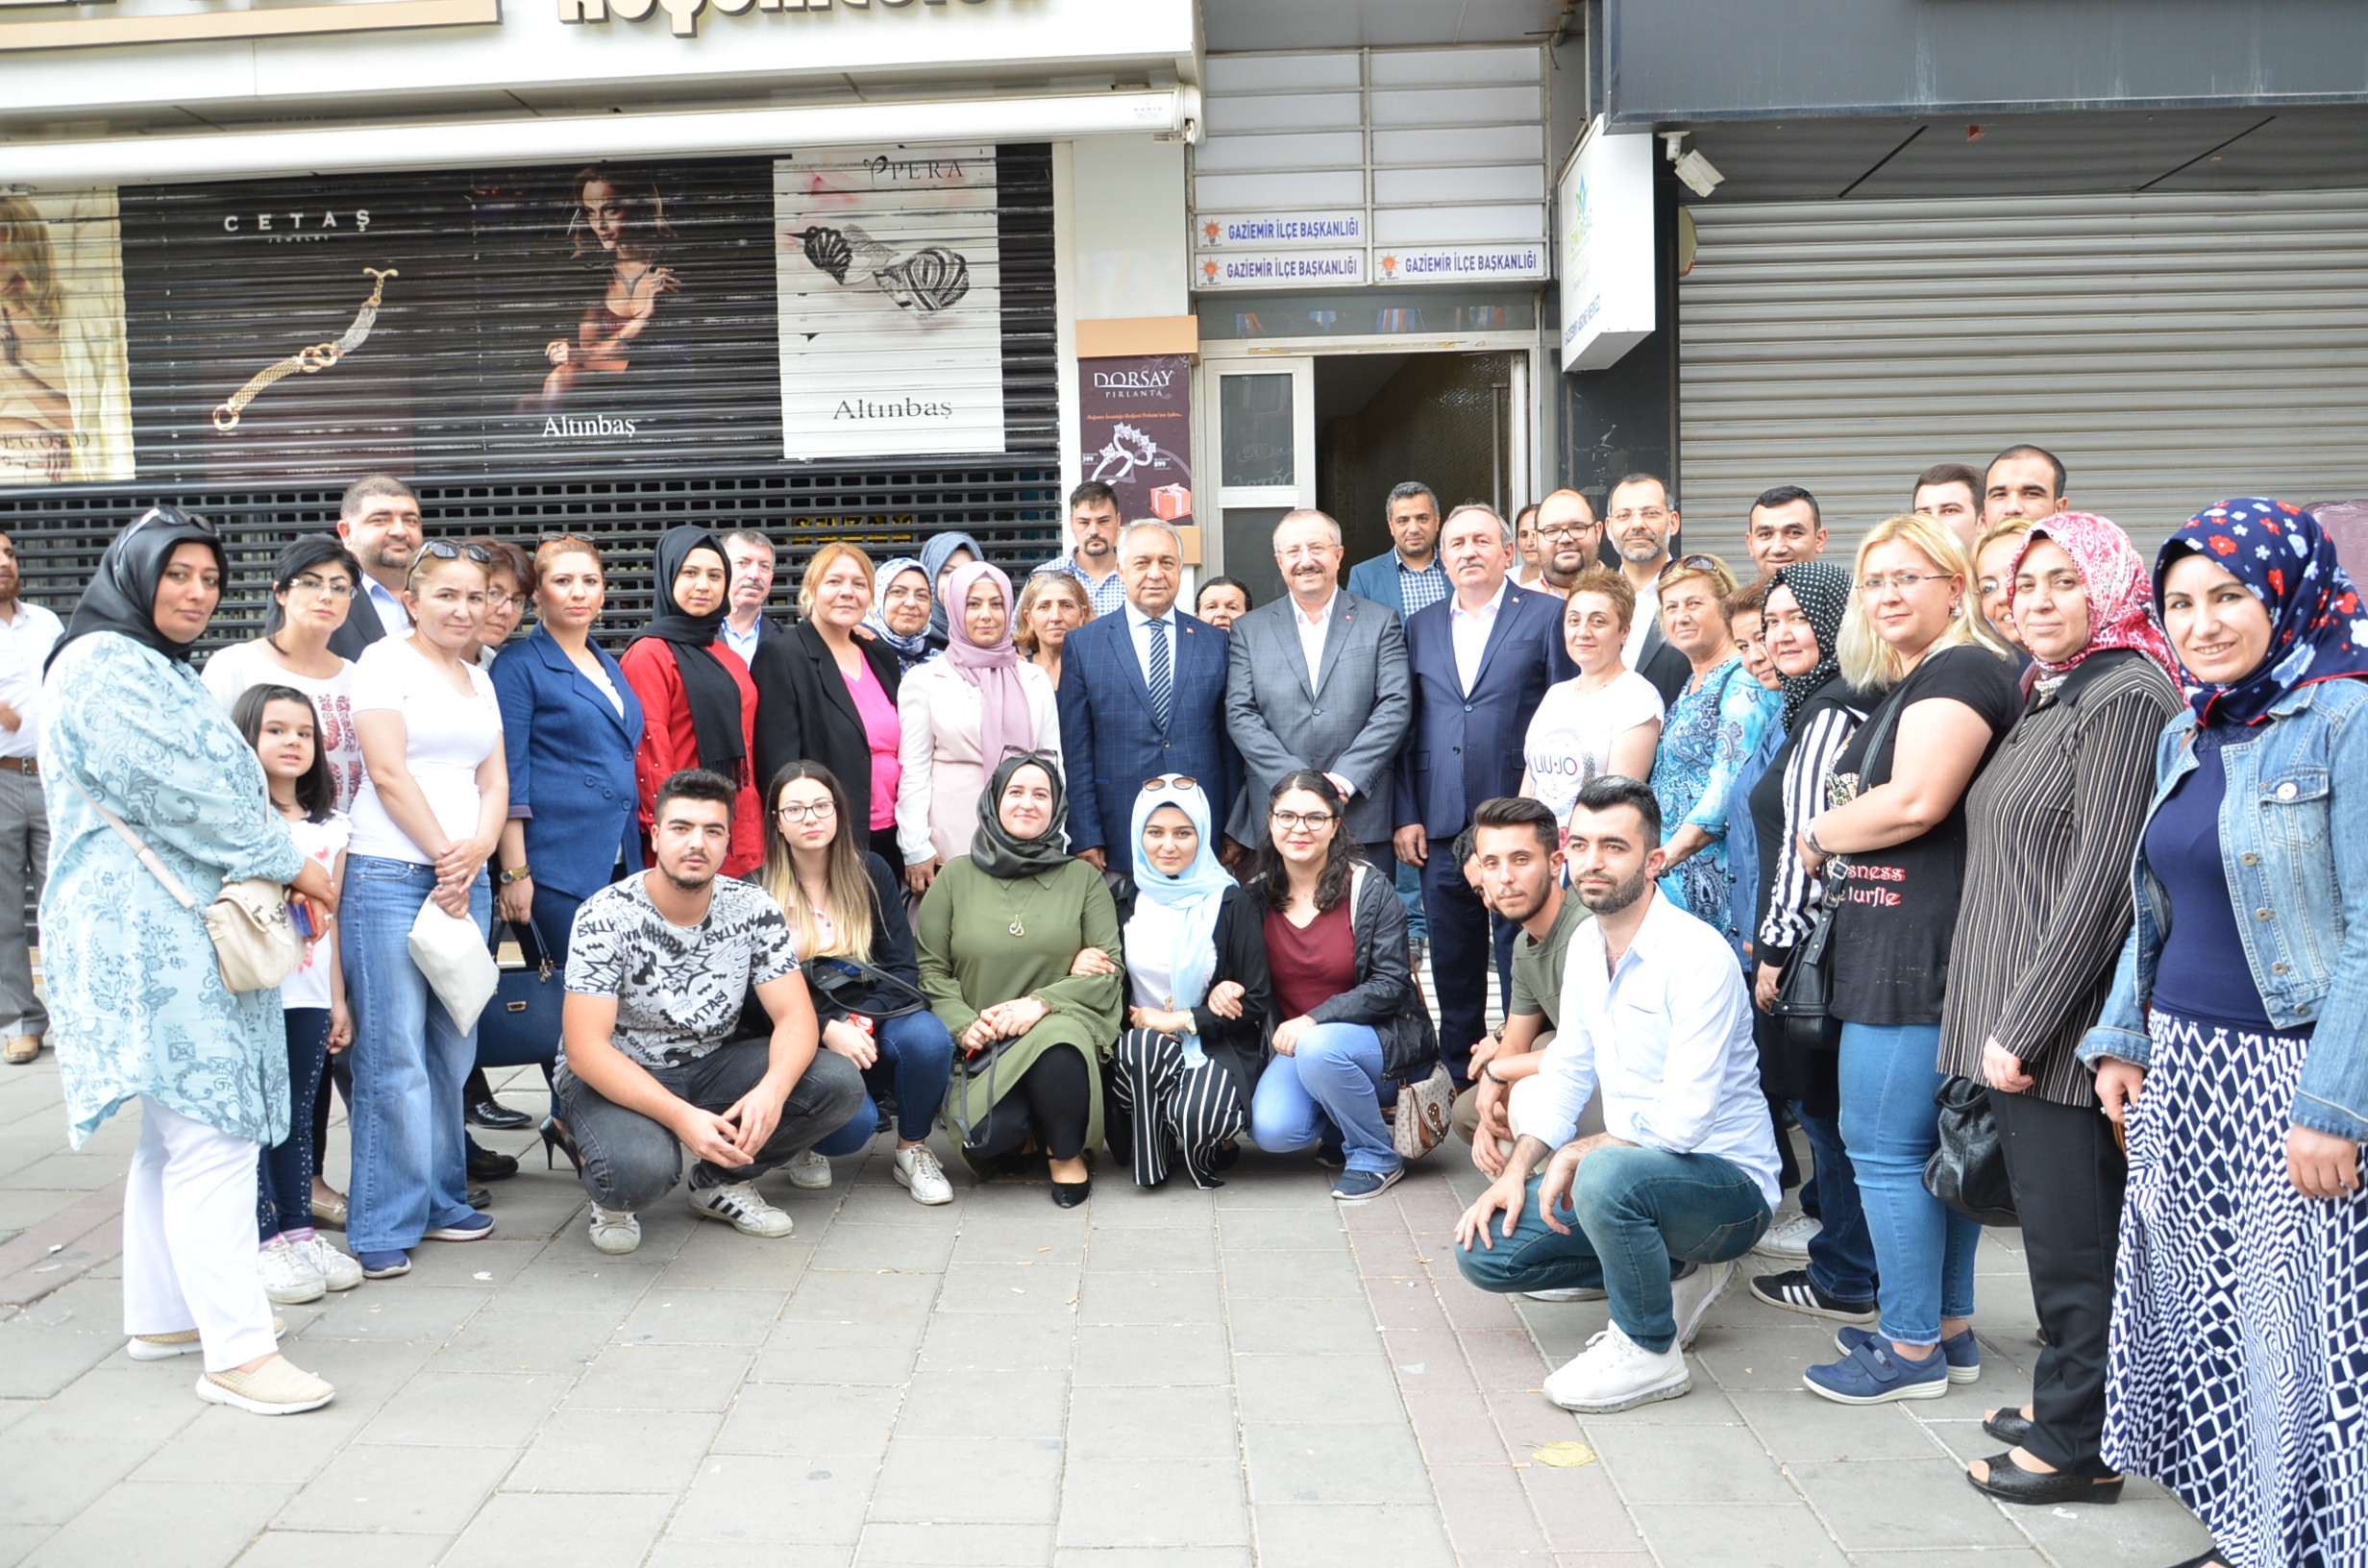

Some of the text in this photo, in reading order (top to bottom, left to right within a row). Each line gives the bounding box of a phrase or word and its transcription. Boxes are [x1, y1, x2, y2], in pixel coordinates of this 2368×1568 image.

[223, 209, 370, 233] CETAŞ
[1228, 217, 1359, 240] GAZİEMİR İLÇE BAŞKANLIĞI
[1226, 256, 1357, 279] GAZİEMİR İLÇE BAŞKANLIĞI
[1405, 250, 1537, 273] GAZİEMİR İLÇE BAŞKANLIĞI
[1094, 370, 1173, 388] DORSAY
[1105, 389, 1163, 399] PIRLANTA
[832, 397, 952, 420] Altınbaş
[542, 414, 636, 438] Altınbaş
